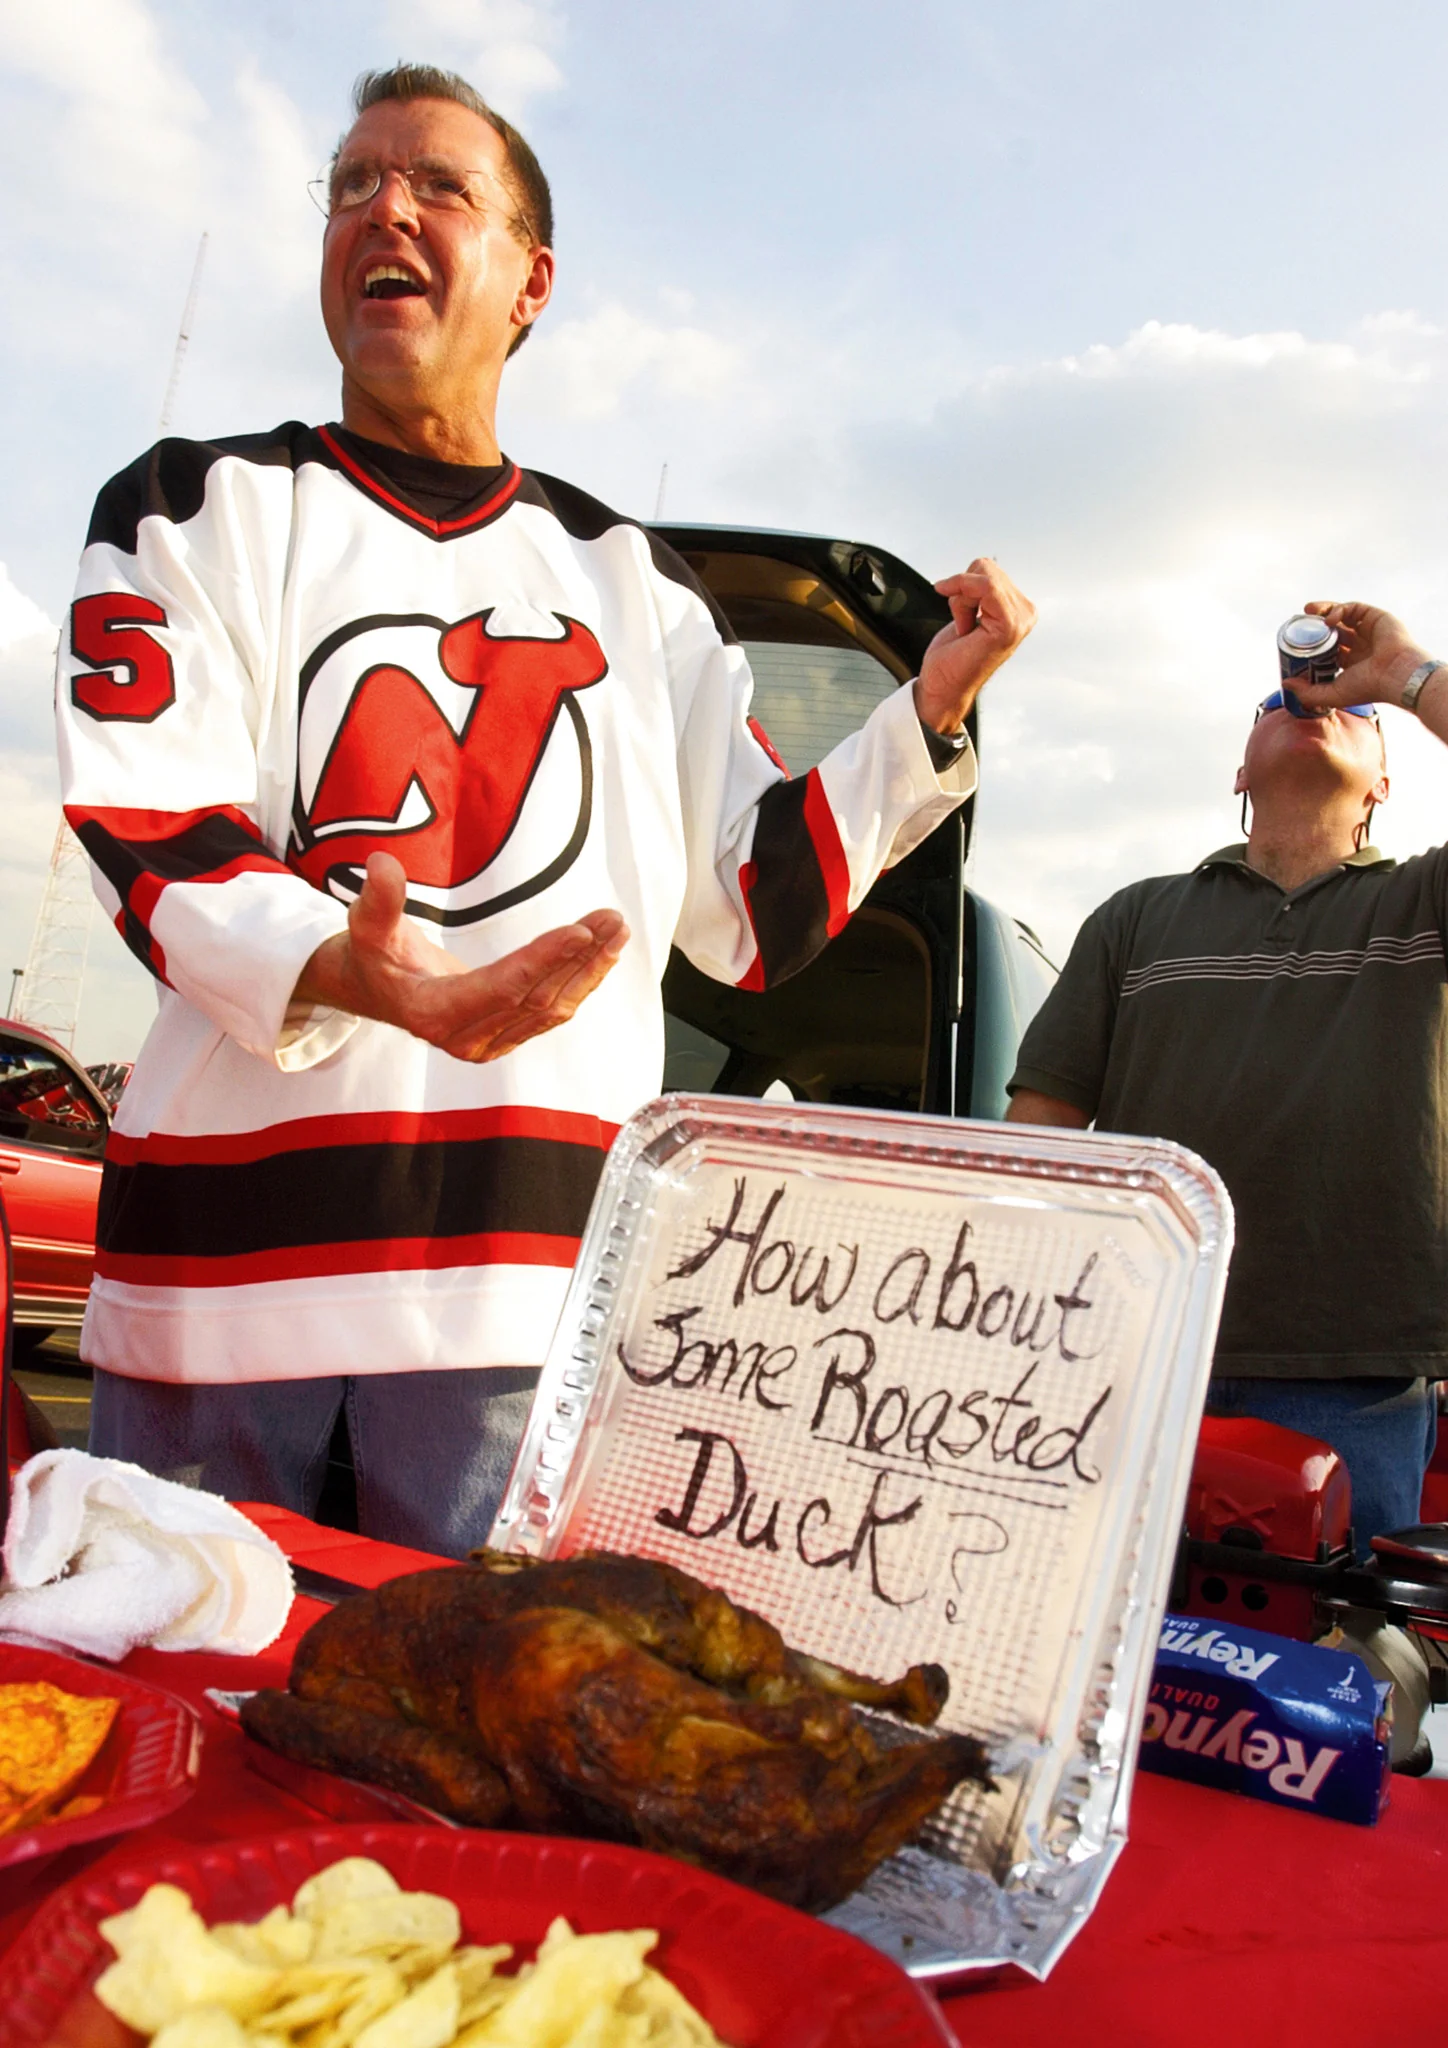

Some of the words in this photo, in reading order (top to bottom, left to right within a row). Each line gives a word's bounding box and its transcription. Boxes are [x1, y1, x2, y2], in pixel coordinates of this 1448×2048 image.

[70, 591, 176, 724] 5
[664, 1176, 859, 1308] How
[873, 1220, 1101, 1363] about
[617, 1305, 797, 1410] Some
[811, 1328, 1112, 1484] Roasted
